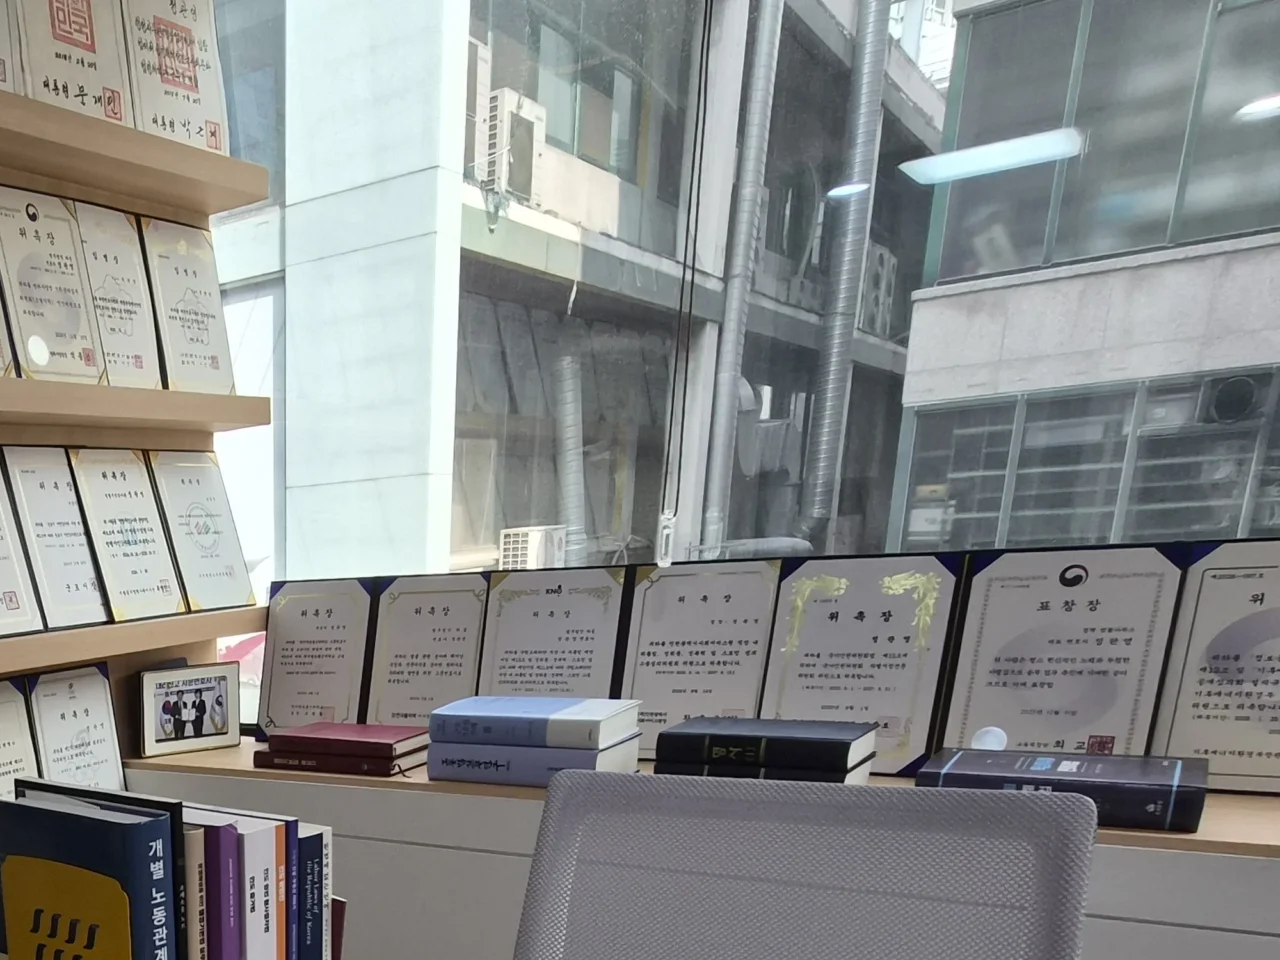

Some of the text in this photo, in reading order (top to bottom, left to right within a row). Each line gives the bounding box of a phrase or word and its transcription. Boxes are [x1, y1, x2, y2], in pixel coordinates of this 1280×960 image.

[148, 838, 165, 880] 개별
[305, 874, 313, 910] Republic
[304, 911, 313, 920] of
[312, 905, 320, 914] of
